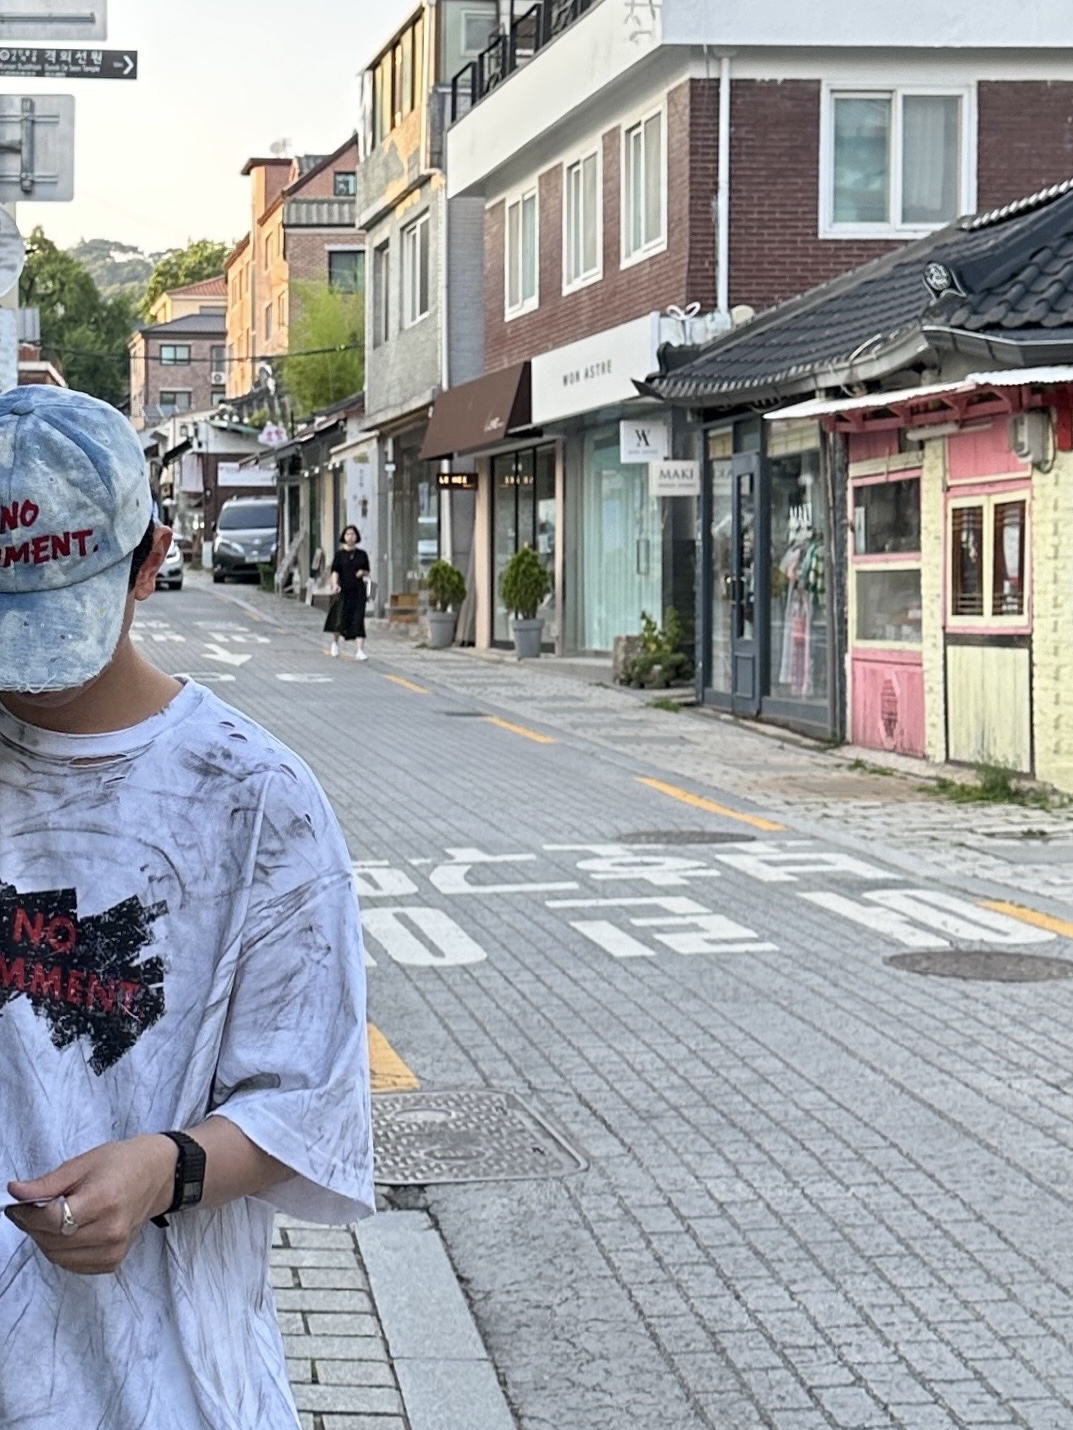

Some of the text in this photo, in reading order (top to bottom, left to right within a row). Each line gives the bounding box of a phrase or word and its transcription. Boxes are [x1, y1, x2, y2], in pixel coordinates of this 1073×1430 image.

[659, 469, 695, 481] MAKI
[0, 499, 40, 535] NO
[12, 906, 78, 953] NO
